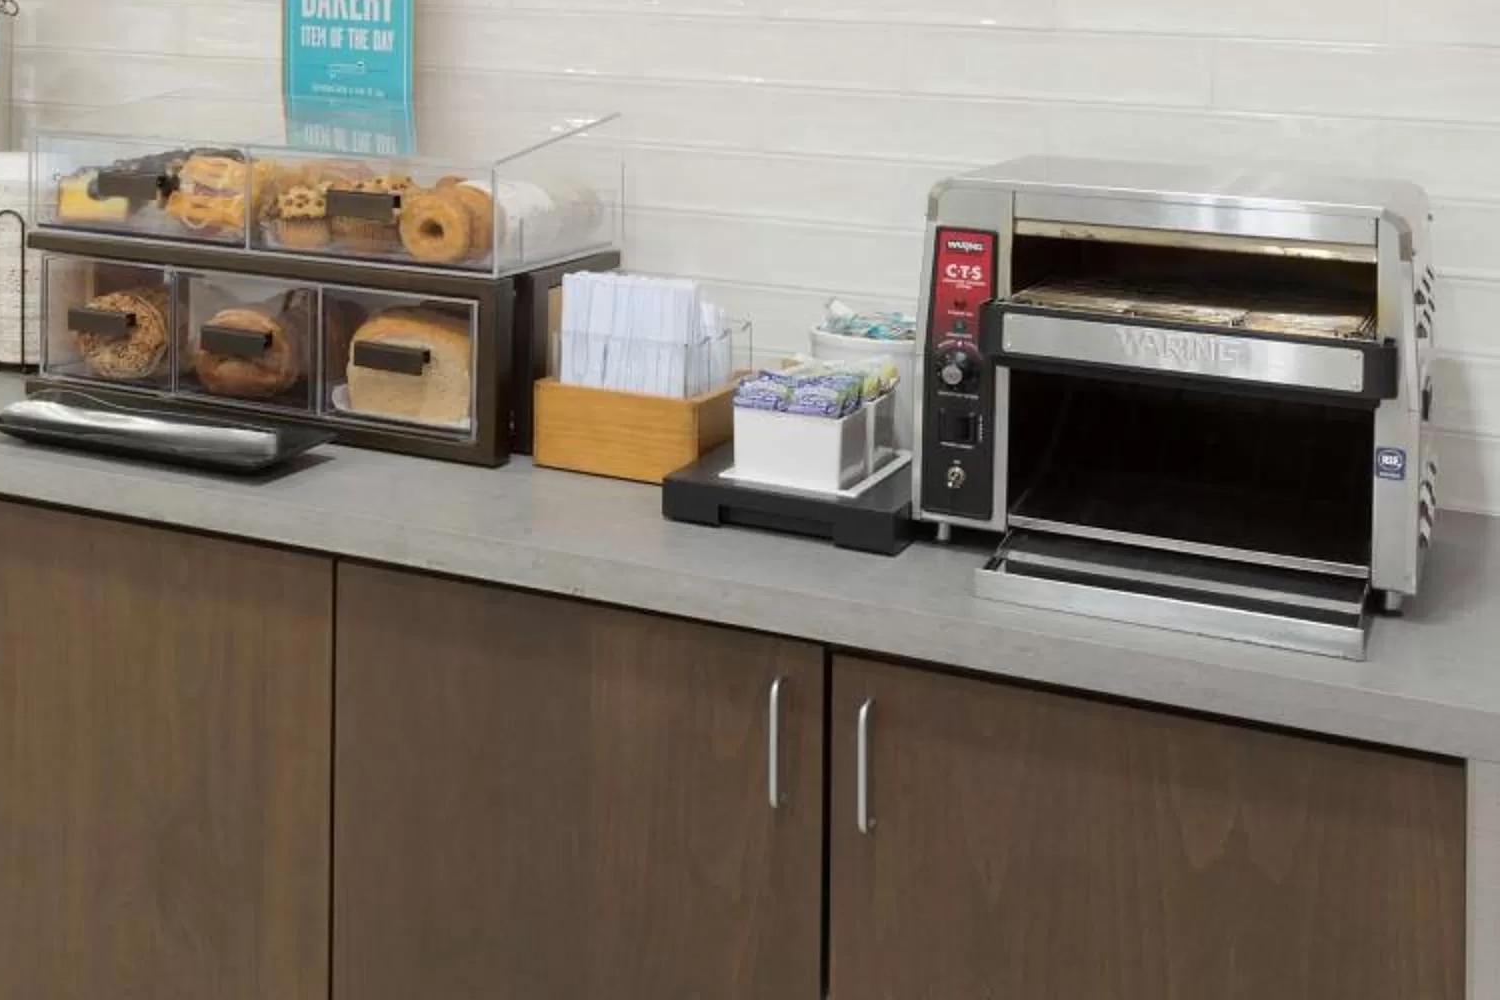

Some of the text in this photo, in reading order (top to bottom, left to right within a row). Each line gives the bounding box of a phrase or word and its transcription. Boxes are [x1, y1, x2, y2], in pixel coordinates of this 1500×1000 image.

[301, 24, 395, 52] ITEM OF THE DAY
[1115, 327, 1246, 365] WARING
